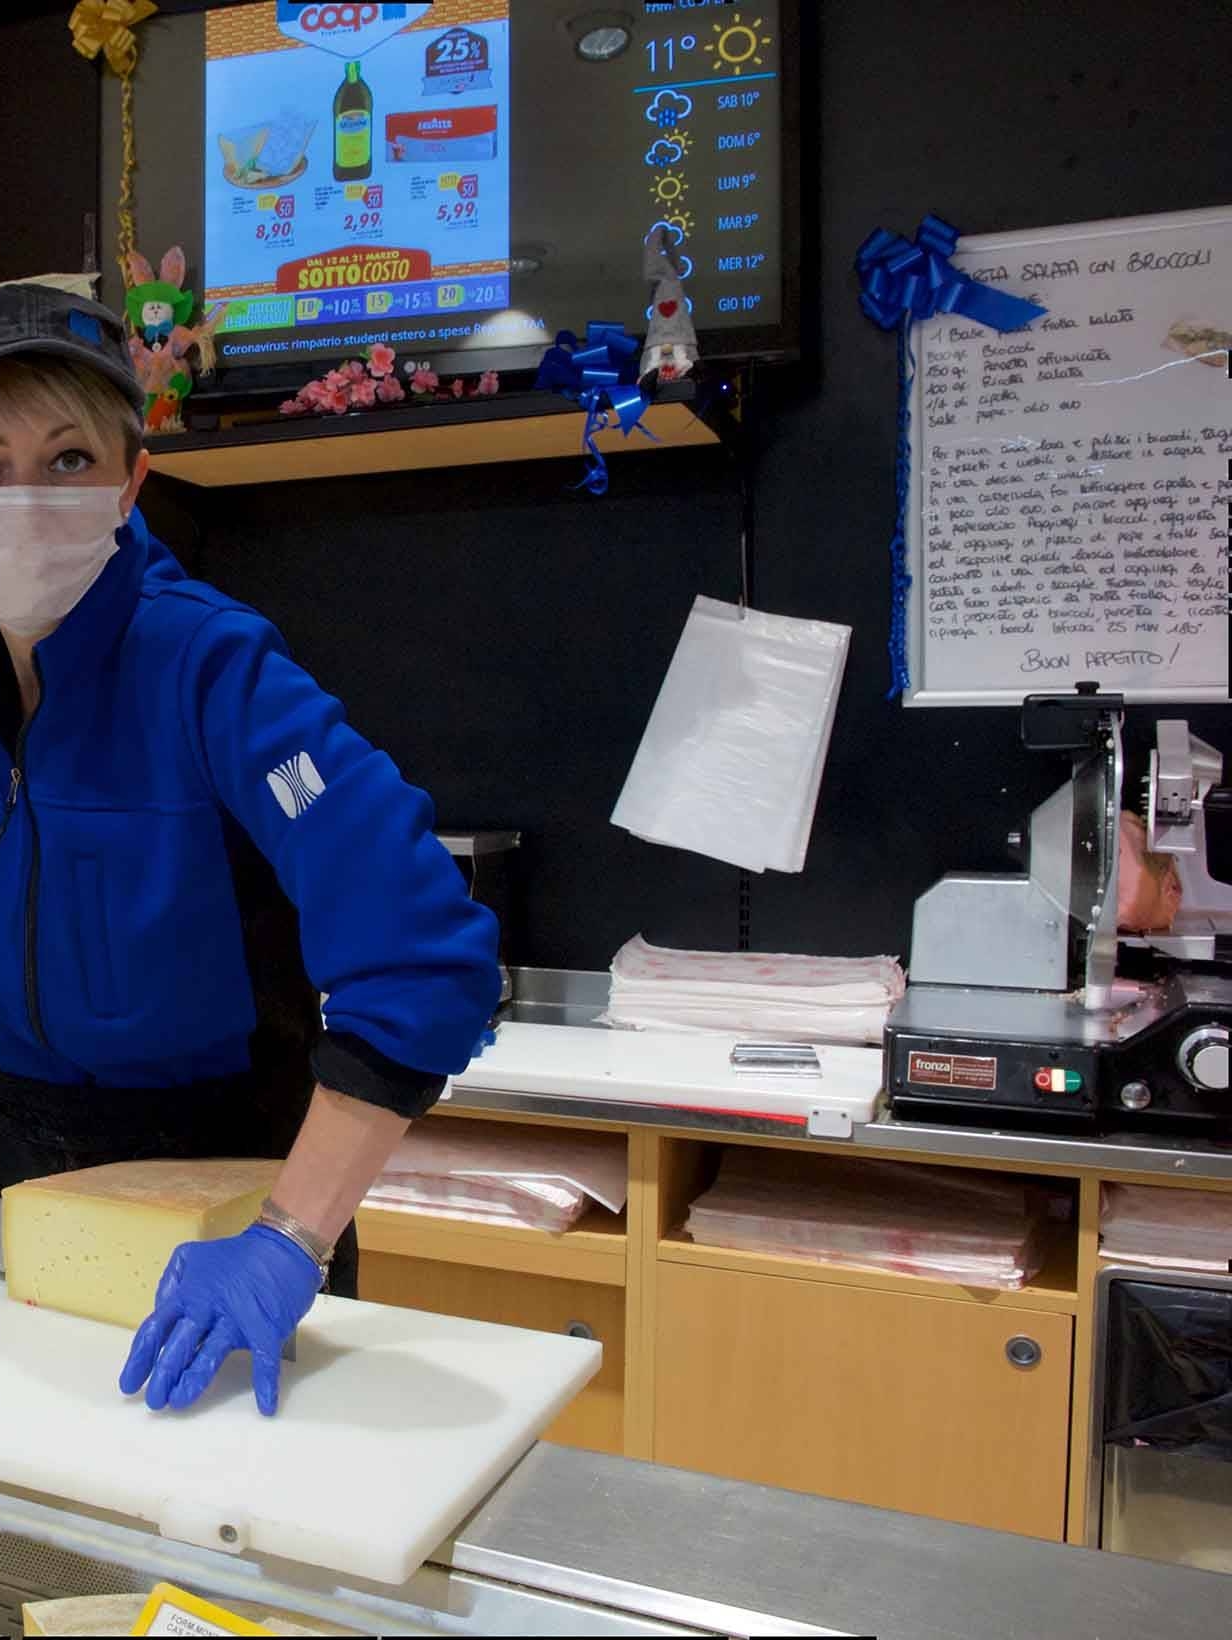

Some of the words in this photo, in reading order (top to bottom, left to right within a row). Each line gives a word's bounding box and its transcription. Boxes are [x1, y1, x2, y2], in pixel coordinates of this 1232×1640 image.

[299, 3, 379, 32] coop
[645, 35, 696, 72] 11°
[718, 95, 738, 110] SAB
[740, 91, 760, 106] 10°
[718, 134, 744, 149] DOM
[746, 131, 761, 146] 6°
[718, 176, 740, 190] LUN
[742, 173, 757, 188] 9°
[437, 202, 474, 222] 5,99
[718, 216, 743, 230] MAR
[744, 213, 759, 228] 9°
[255, 221, 292, 241] 8,90
[344, 212, 380, 232] 2,99
[306, 259, 323, 267] DAL
[339, 255, 350, 264] AL
[366, 250, 400, 261] MARZO
[718, 256, 743, 271] MER
[744, 253, 765, 268] 12°
[1021, 259, 1079, 281] SALATA
[1088, 259, 1115, 274] CON
[1126, 249, 1211, 273] BROCCOLI
[718, 297, 738, 311] GIO
[740, 294, 761, 309] 10°
[1089, 307, 1134, 326] salata
[223, 341, 289, 356] Coronavirus:
[291, 335, 341, 351] rimpatrio
[343, 330, 389, 346] studenti
[391, 328, 426, 342] estero
[428, 329, 436, 338] a
[439, 325, 474, 341] spese
[928, 412, 956, 428] Sale
[1106, 621, 1128, 633] 25
[1135, 622, 1160, 632] MIN
[1020, 648, 1070, 673] BUON
[915, 1058, 951, 1072] fronza
